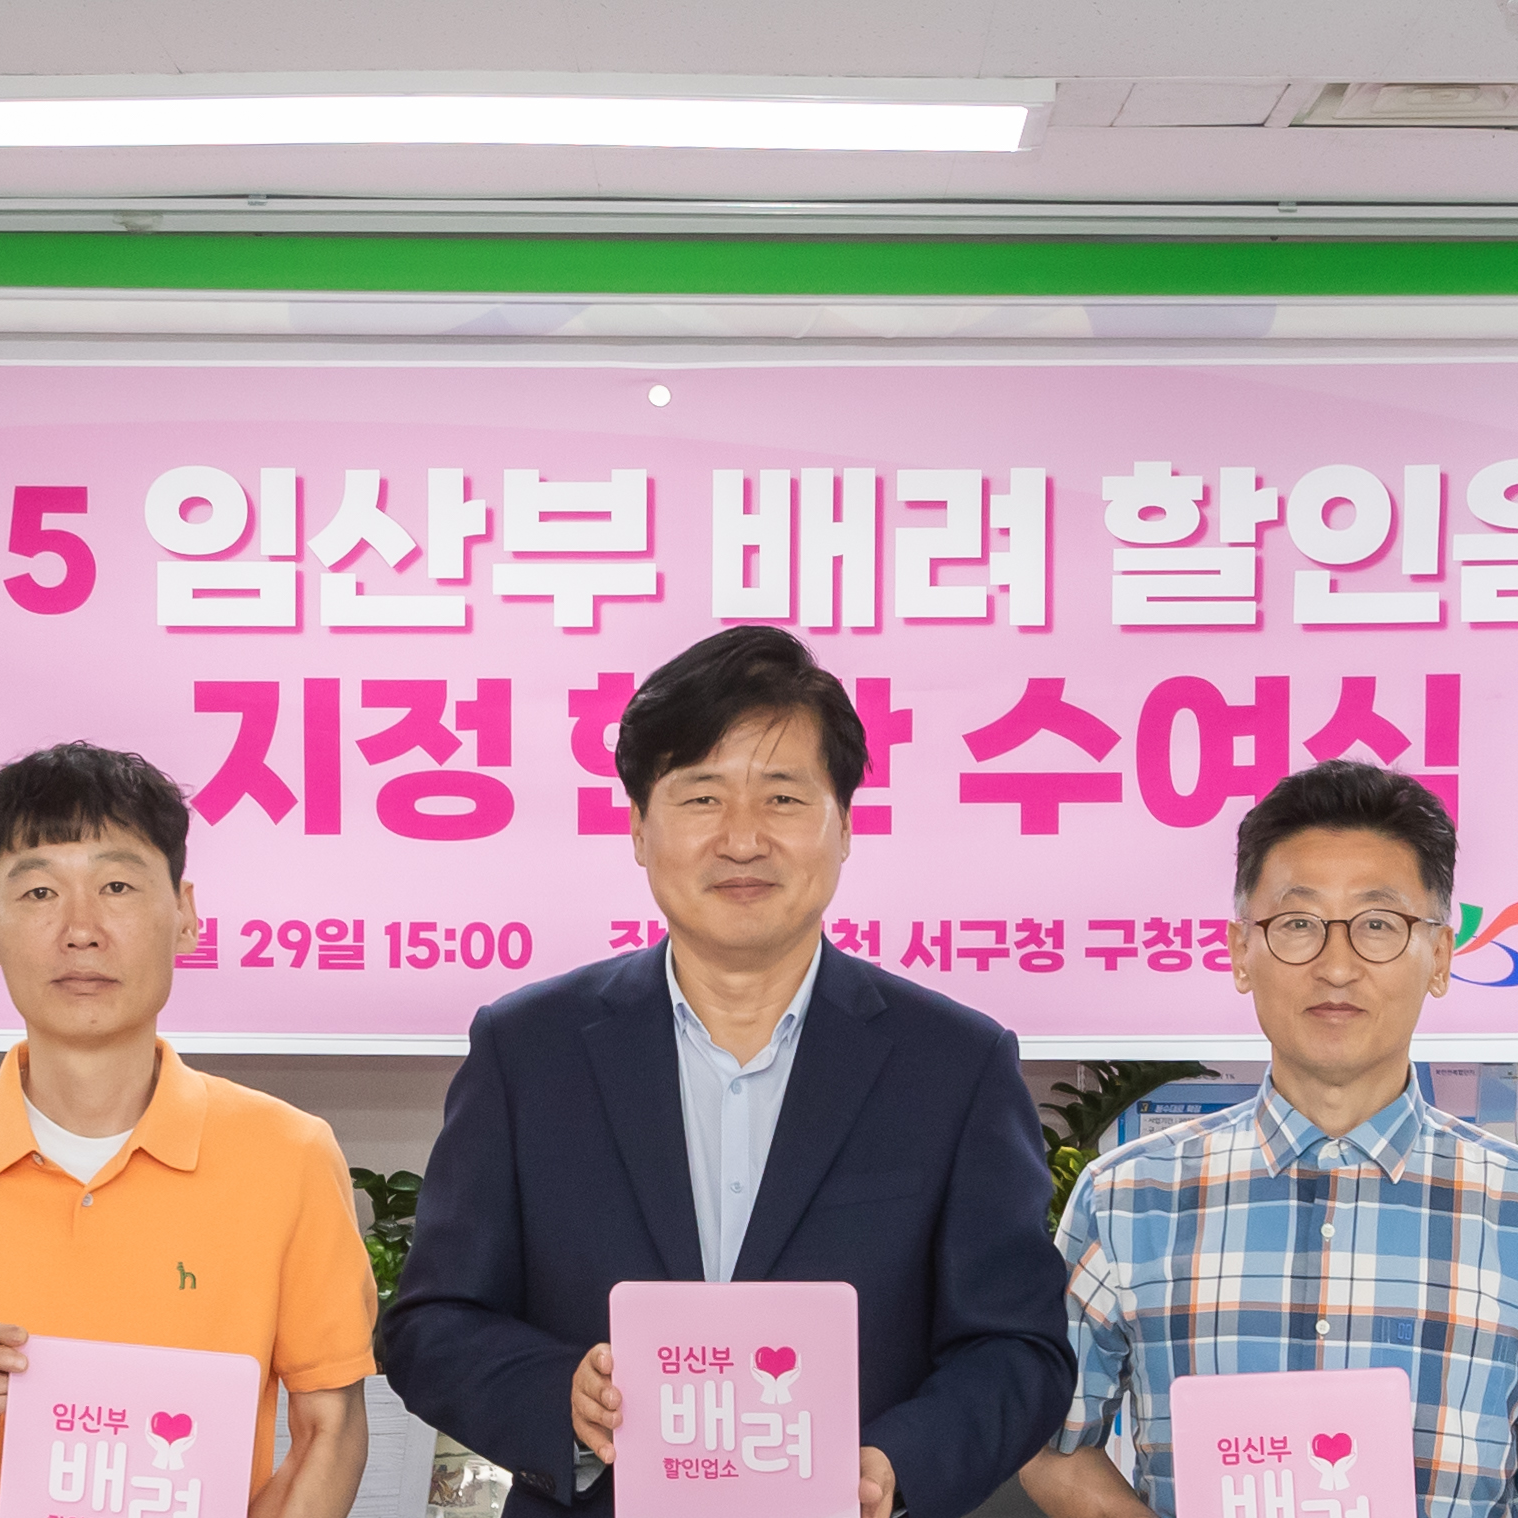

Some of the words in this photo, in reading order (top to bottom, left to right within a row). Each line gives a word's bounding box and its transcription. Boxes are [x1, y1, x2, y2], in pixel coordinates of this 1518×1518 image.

[143, 465, 661, 632] 임산부
[711, 466, 1051, 632] 배려
[190, 677, 515, 841] 지정
[239, 917, 365, 971] 29일
[384, 920, 534, 971] 15:00
[821, 917, 881, 967] 천
[899, 916, 1066, 974] 서구청
[656, 1345, 735, 1375] 임신부
[52, 1403, 130, 1436] 임신부
[659, 1379, 813, 1480] 배려
[662, 1457, 739, 1481] 할인업소
[1216, 1435, 1293, 1467] 임신부
